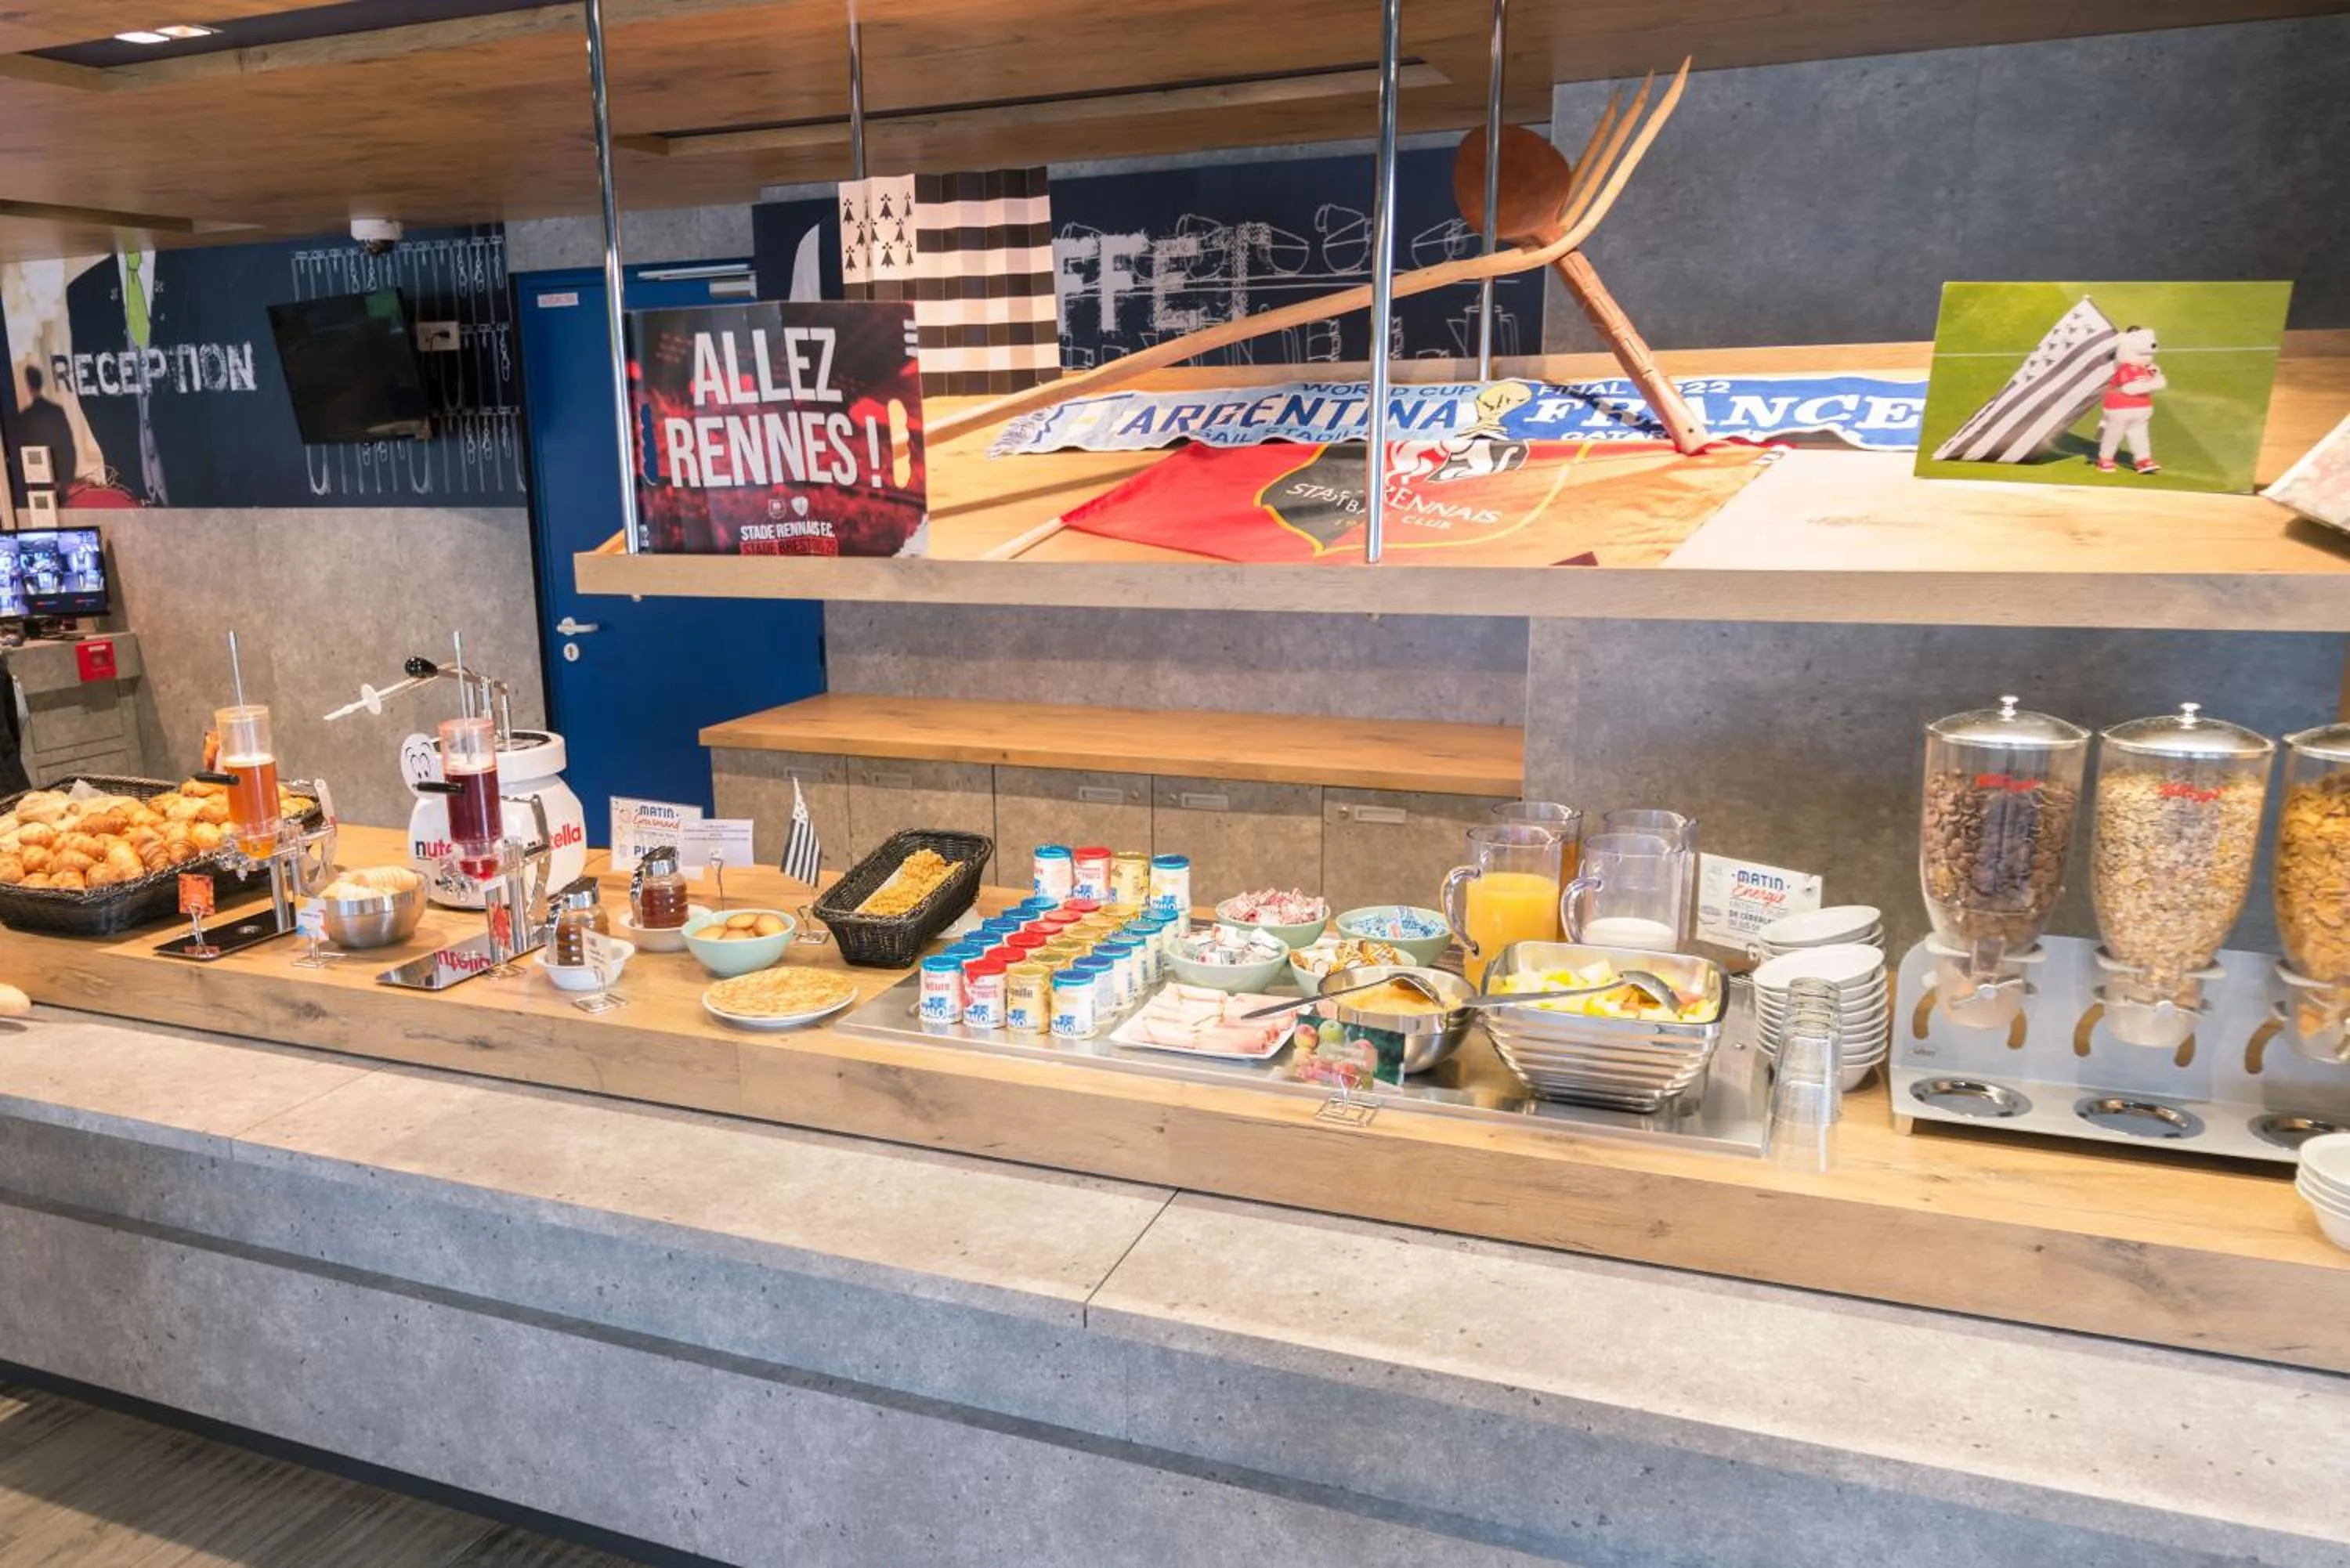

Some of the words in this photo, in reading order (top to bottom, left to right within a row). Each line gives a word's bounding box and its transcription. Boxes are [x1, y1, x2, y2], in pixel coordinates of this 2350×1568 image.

[50, 341, 258, 396] RECEPTION
[693, 327, 844, 406] ALLEZ
[1303, 383, 1409, 397] WORD
[1419, 385, 1477, 397] CUP
[1538, 382, 1627, 396] FINAL
[740, 525, 776, 541] STADE
[776, 520, 819, 539] RENNAIS
[1401, 515, 1453, 530] CLUB
[640, 806, 675, 818] MATIN
[1737, 869, 1784, 891] MATIN
